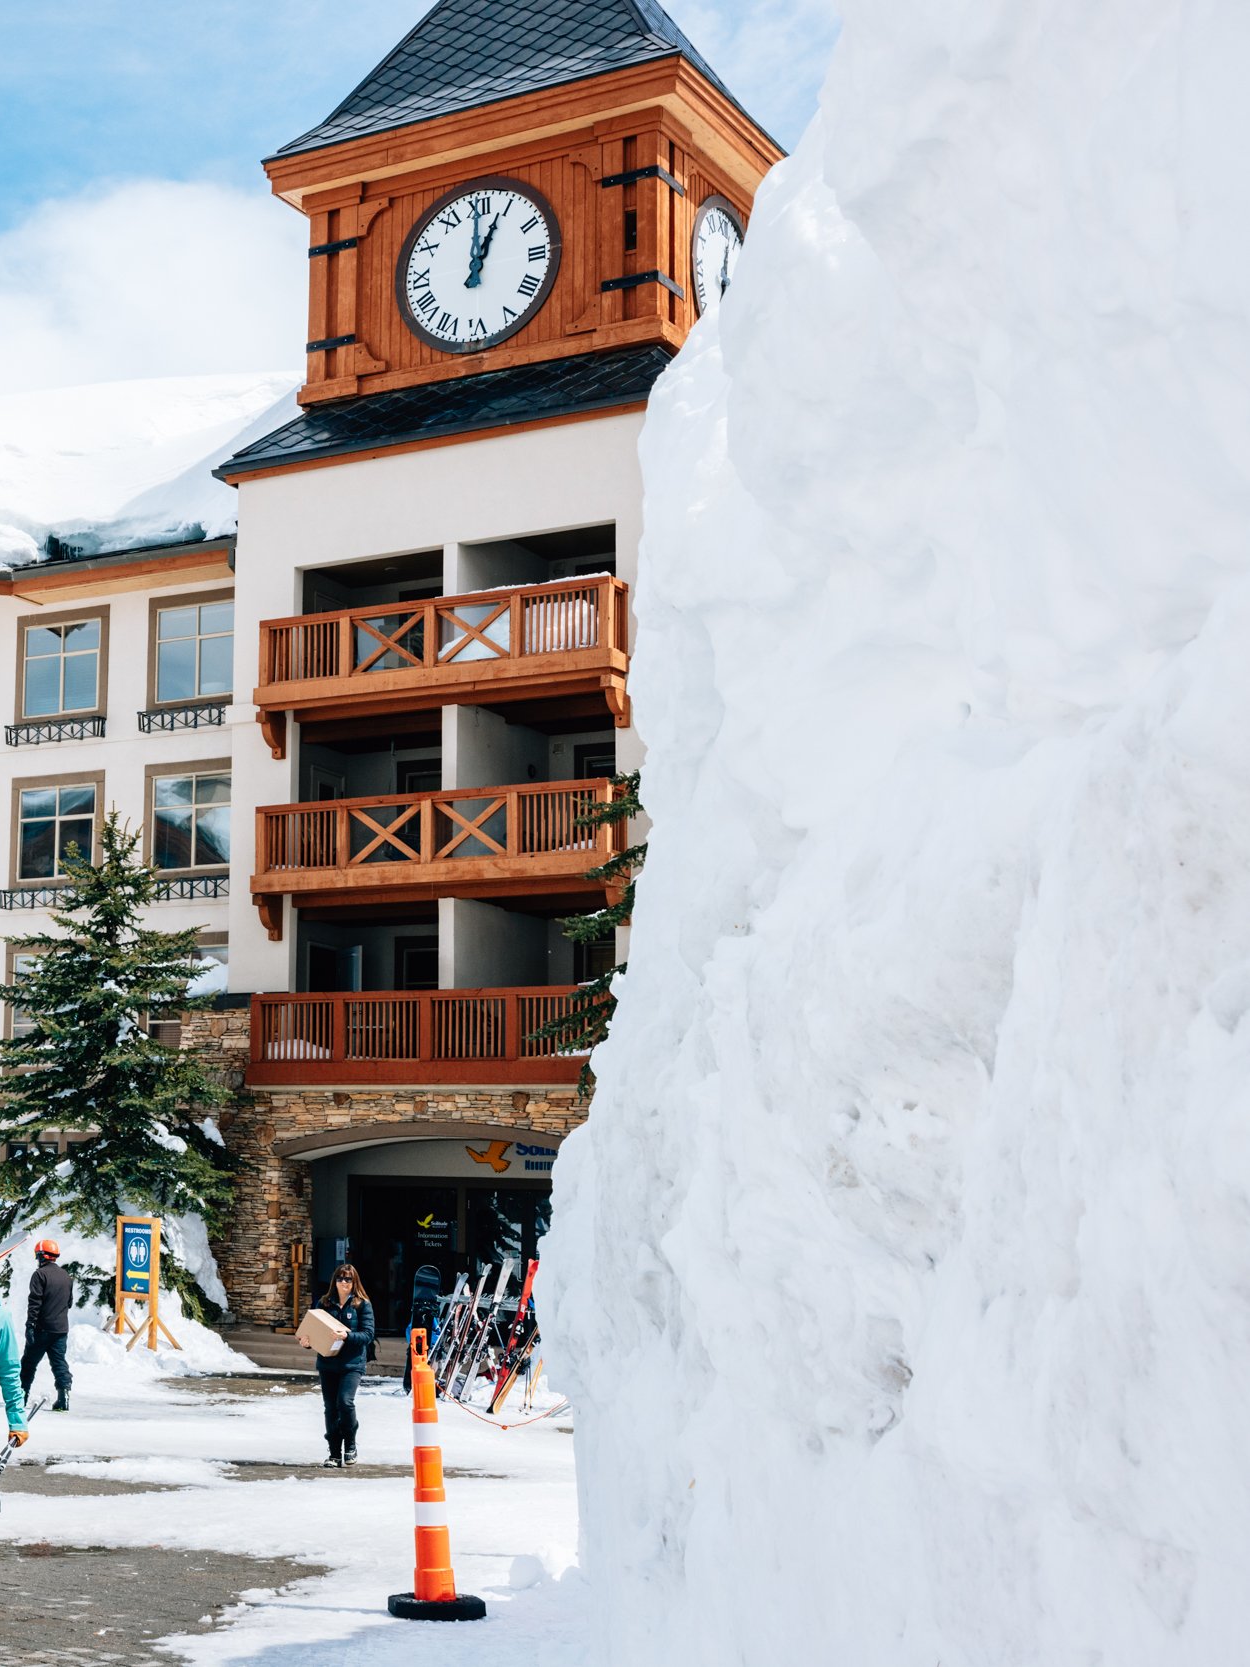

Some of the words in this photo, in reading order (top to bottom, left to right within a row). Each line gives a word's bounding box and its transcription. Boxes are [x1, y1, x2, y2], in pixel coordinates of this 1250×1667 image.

[467, 196, 491, 219] XII
[439, 209, 462, 235] XI
[520, 216, 539, 234] II
[419, 239, 440, 257] X
[528, 245, 546, 262] III
[413, 267, 430, 290] IX
[517, 273, 541, 298] IIII
[416, 290, 440, 322] VIII
[503, 306, 518, 324] V
[436, 312, 459, 336] VII
[125, 1227, 151, 1235] RESTROOMS
